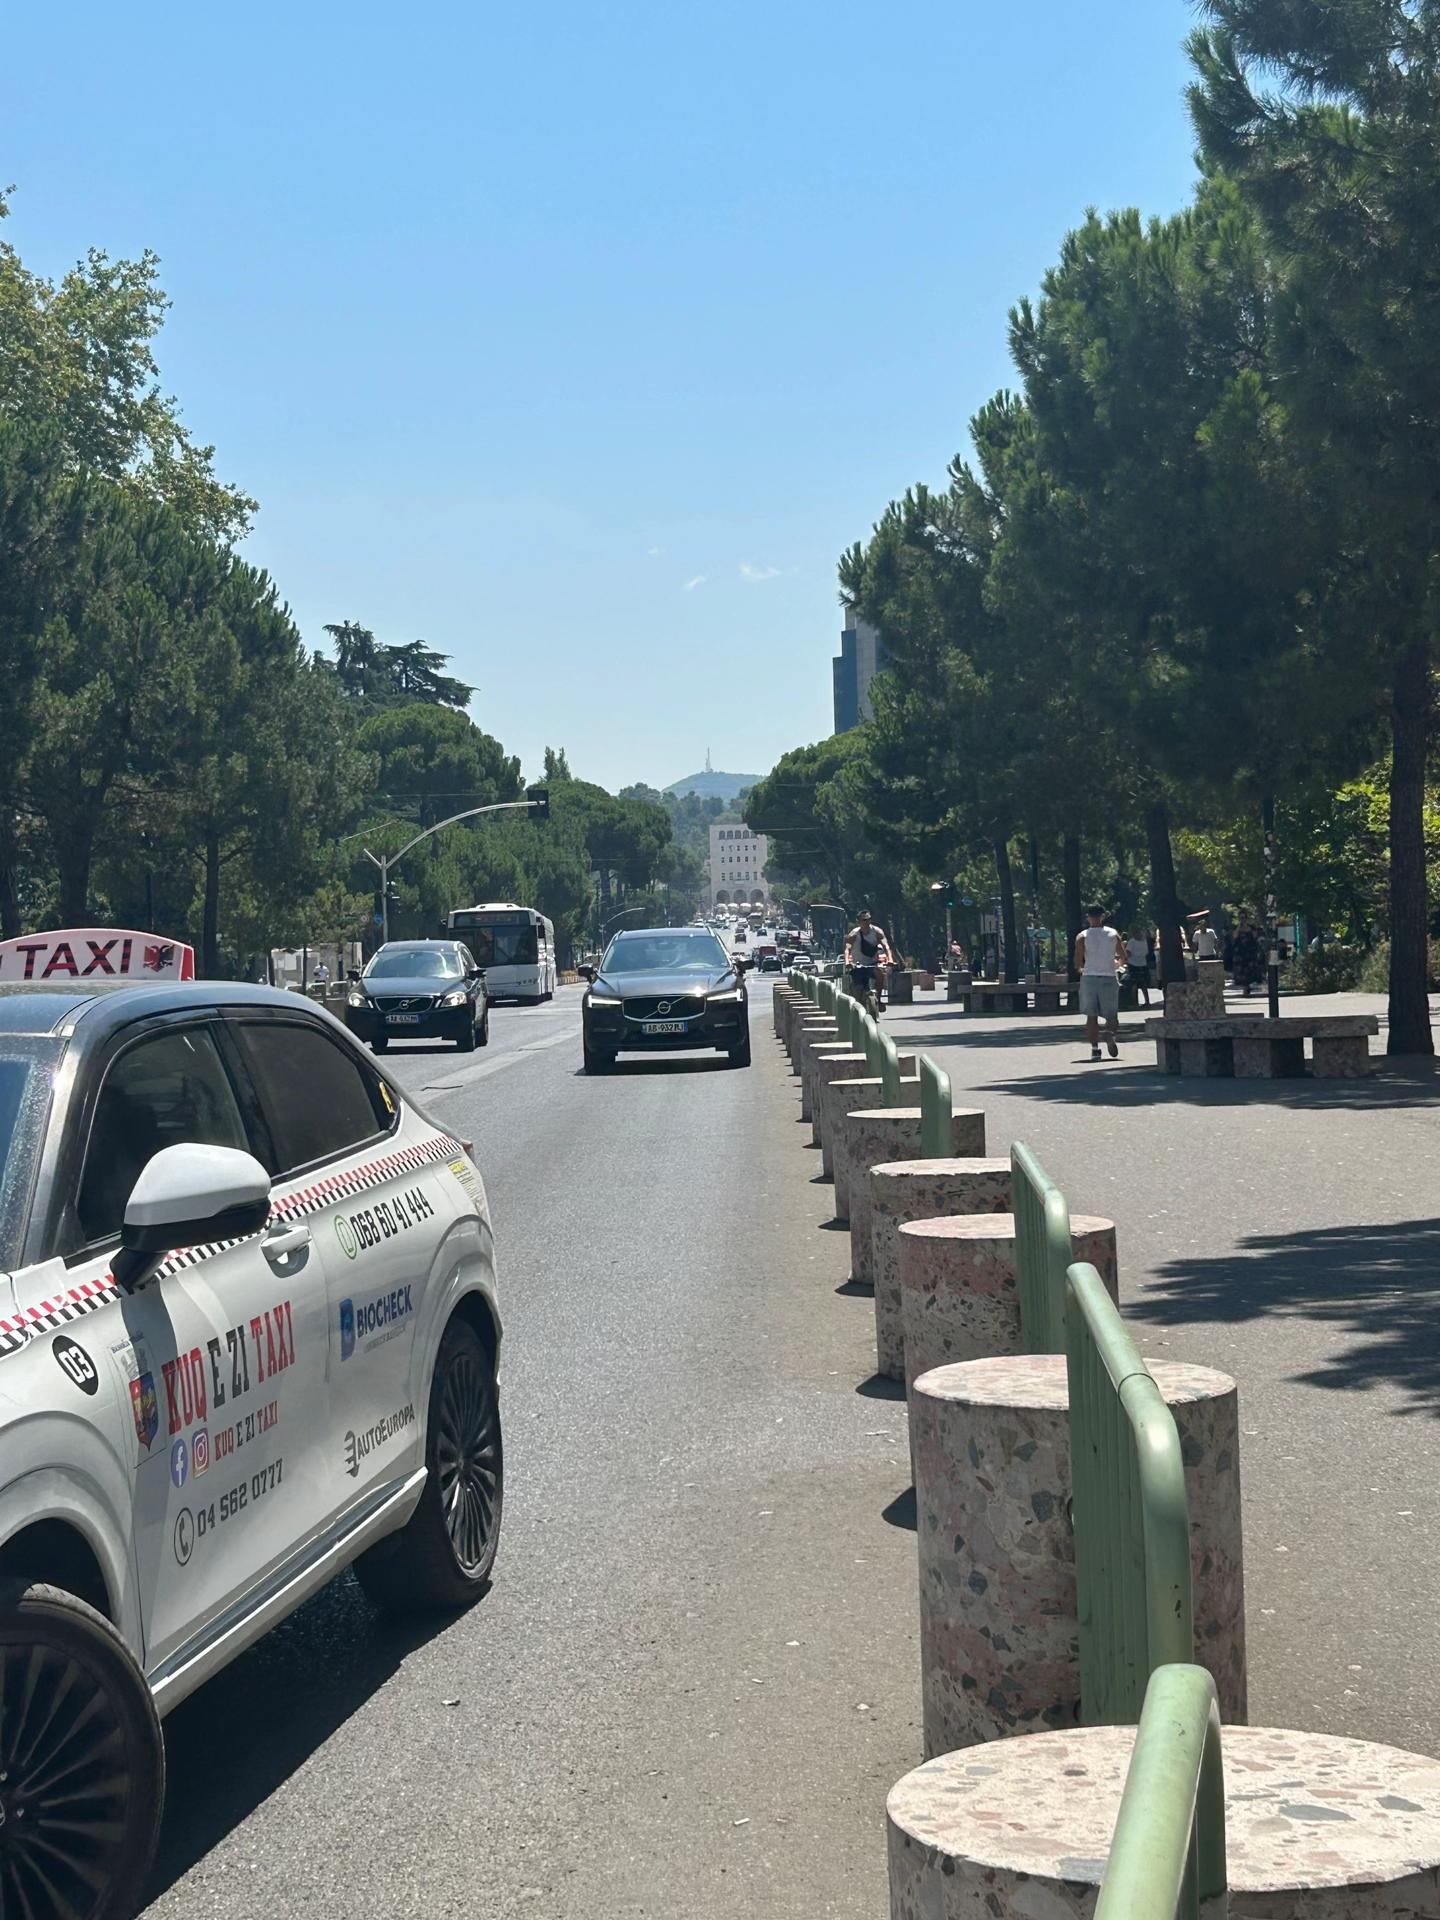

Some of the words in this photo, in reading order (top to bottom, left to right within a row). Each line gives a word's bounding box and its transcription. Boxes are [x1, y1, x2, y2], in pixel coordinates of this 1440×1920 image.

[16, 938, 133, 980] TAXI
[350, 1210, 381, 1250] 068
[373, 1202, 398, 1238] 60
[392, 1196, 413, 1229] 41
[405, 1187, 434, 1222] 444
[357, 1284, 412, 1338] BIOCHECK
[58, 1345, 95, 1384] 03
[161, 1347, 207, 1435] KUQ
[207, 1337, 225, 1409] E
[226, 1325, 250, 1399] ZI
[250, 1300, 295, 1384] TAXI
[214, 1427, 234, 1461] KUQ
[236, 1421, 243, 1448] E
[245, 1413, 255, 1443] ZI
[256, 1400, 278, 1434] TAXI
[197, 1503, 216, 1537] 04
[220, 1482, 248, 1522] 562
[252, 1458, 283, 1500] 0777
